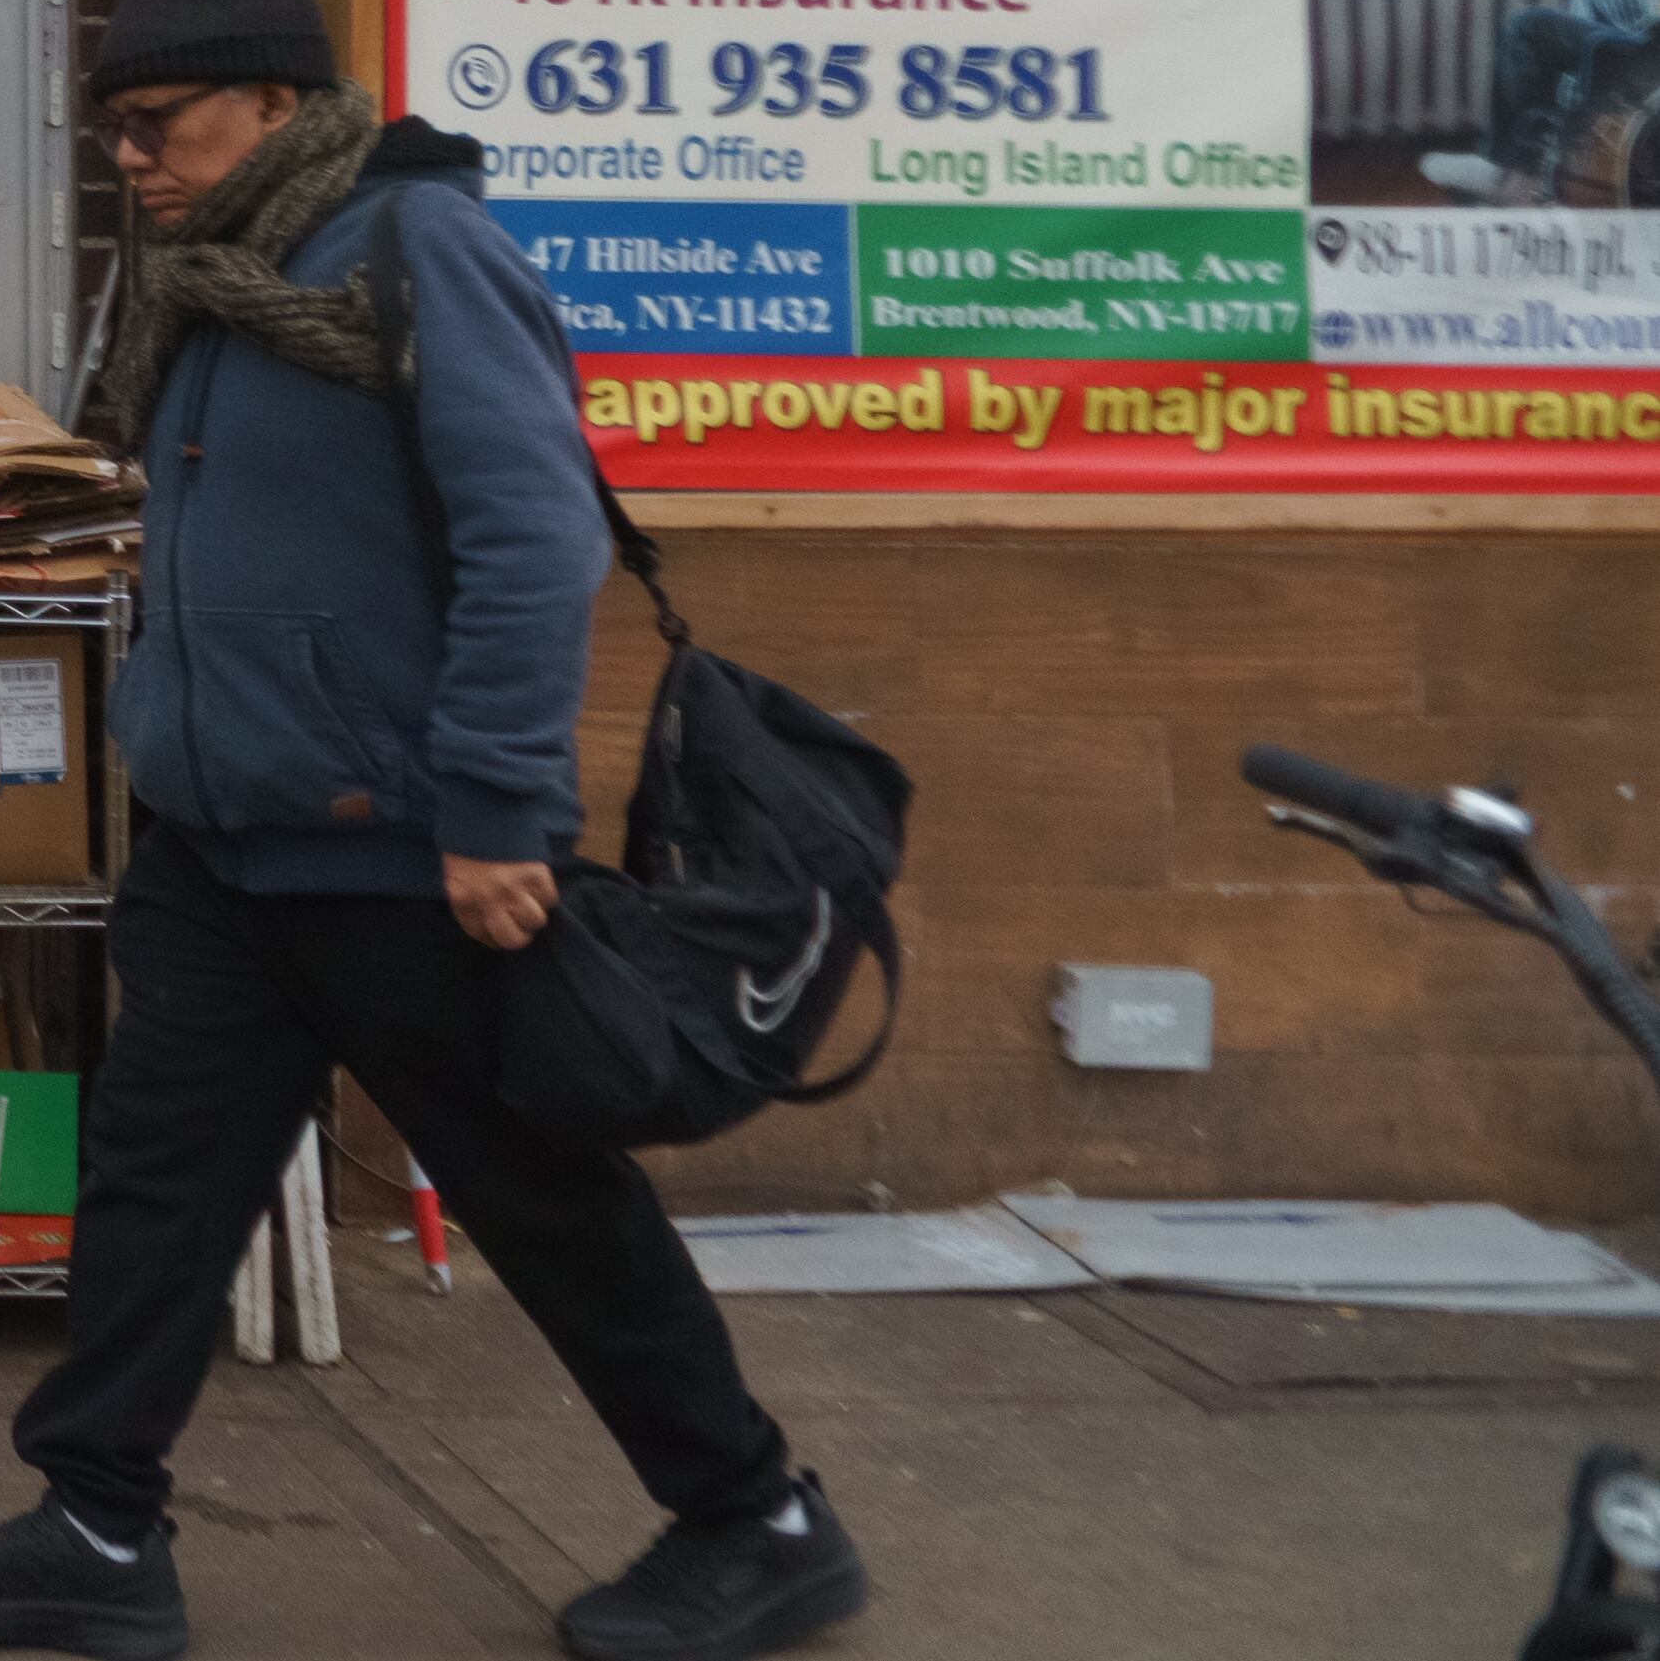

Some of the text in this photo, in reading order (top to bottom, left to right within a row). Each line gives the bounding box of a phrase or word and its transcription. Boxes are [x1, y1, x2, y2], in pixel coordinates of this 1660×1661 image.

[526, 39, 1111, 122] 631 935 8581
[679, 136, 807, 185] Office
[868, 139, 1304, 195] Long Island Office
[583, 366, 1308, 454] approved by major
